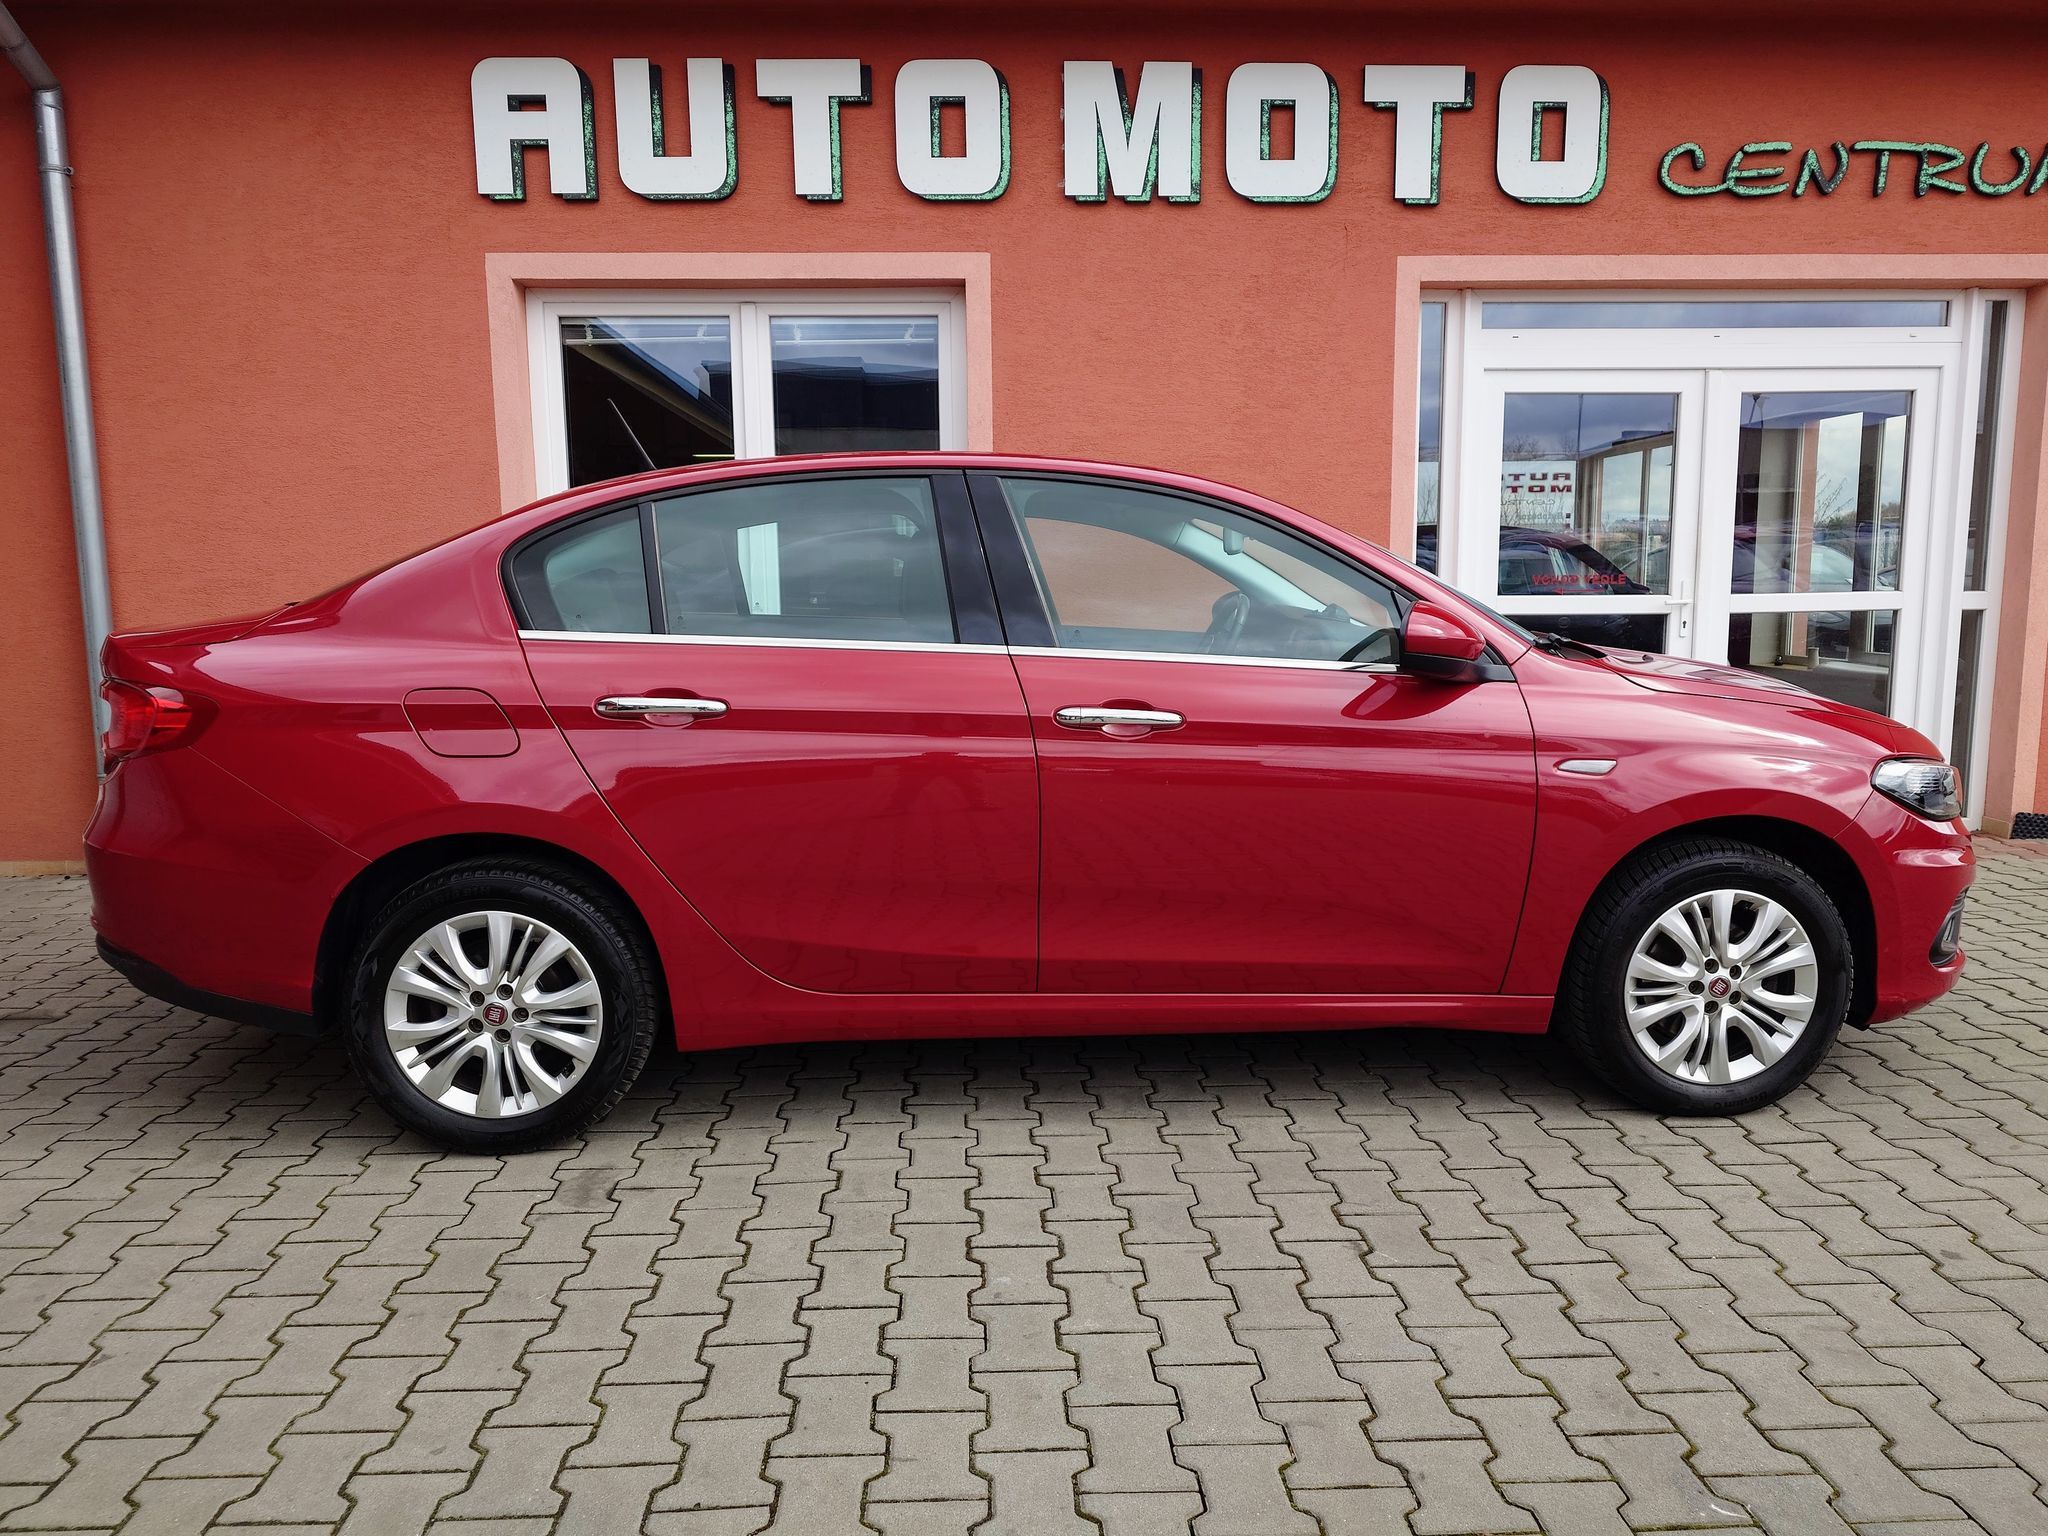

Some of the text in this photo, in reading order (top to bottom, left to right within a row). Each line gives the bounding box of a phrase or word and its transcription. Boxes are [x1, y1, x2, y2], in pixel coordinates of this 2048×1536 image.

[470, 57, 2048, 204] AUTO MOTO CENTRU
[1532, 573, 1627, 585] VCHOD VEDLE
[1712, 980, 1727, 994] FIAT
[488, 1007, 502, 1022] FIAT
